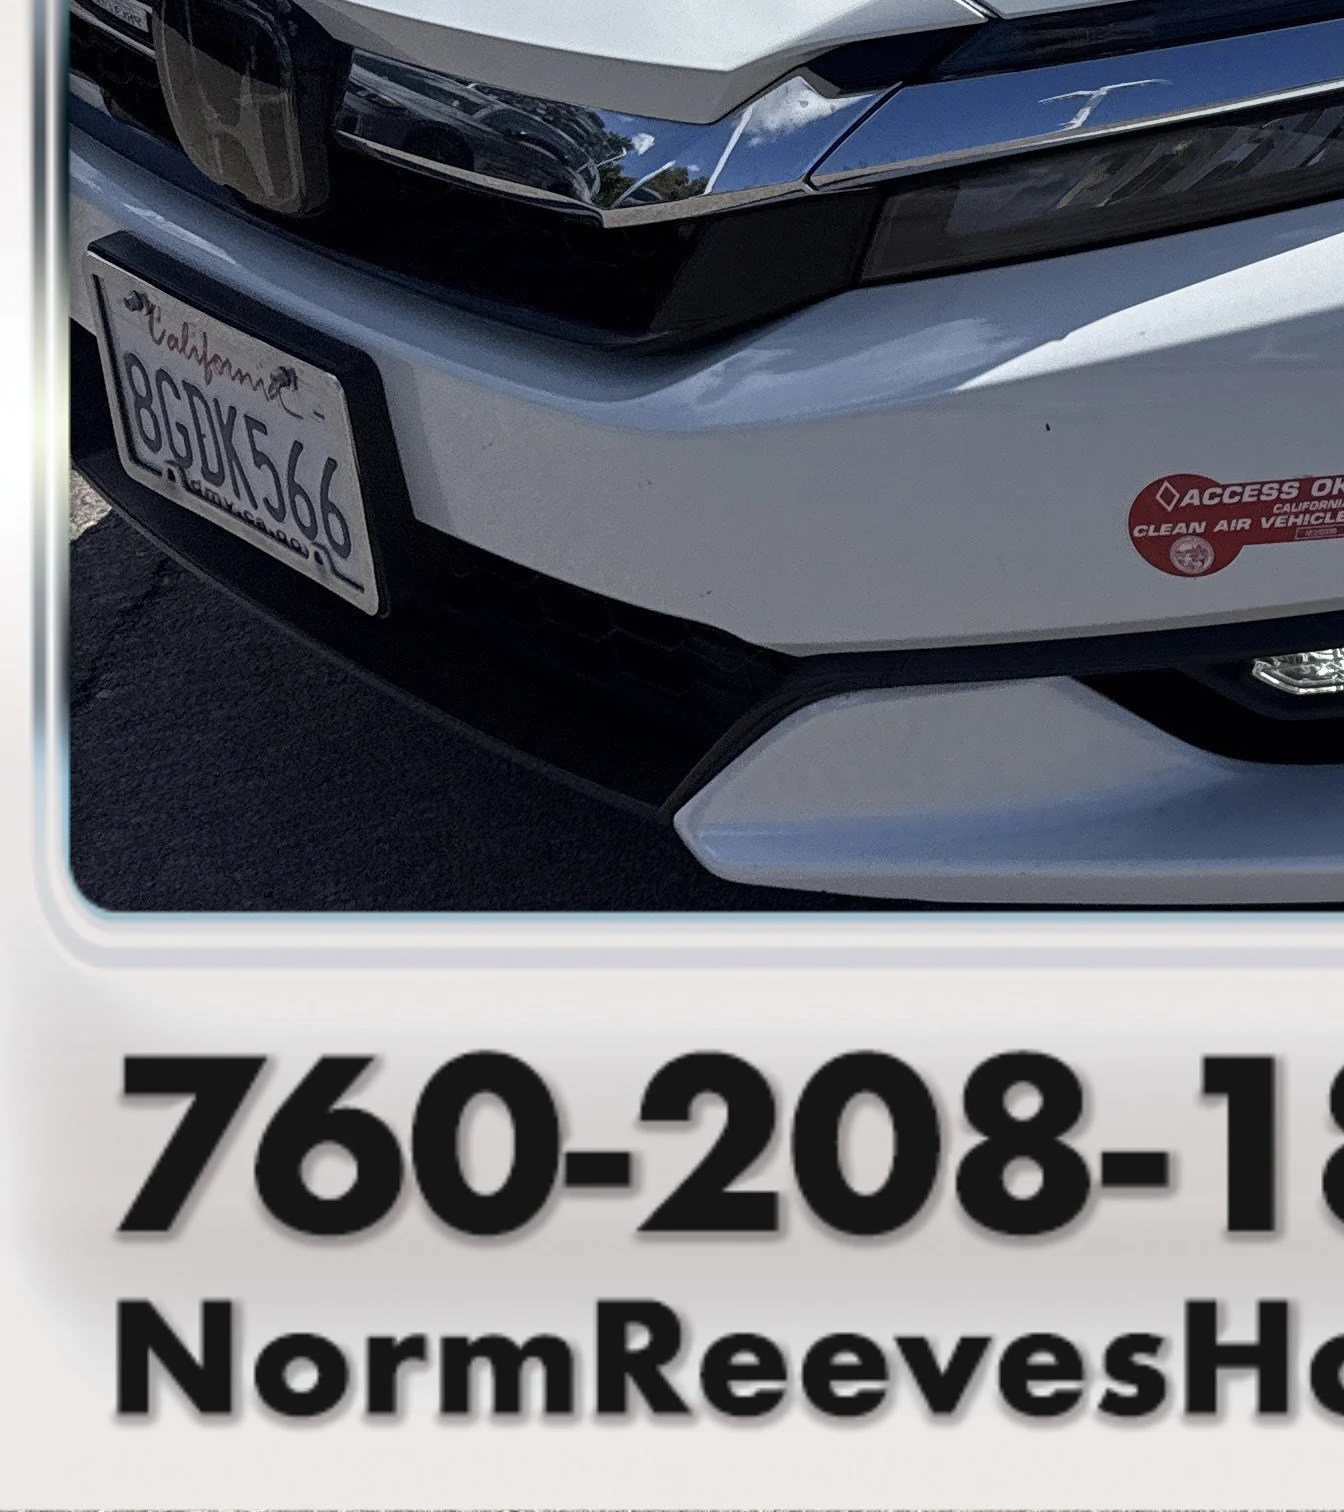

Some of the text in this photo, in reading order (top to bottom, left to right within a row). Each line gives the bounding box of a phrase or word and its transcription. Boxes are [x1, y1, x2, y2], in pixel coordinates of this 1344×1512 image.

[143, 300, 292, 404] California
[123, 352, 352, 560] 8GDK566
[1179, 481, 1301, 508] ACCESS
[1132, 520, 1206, 538] CLEAN
[1212, 517, 1252, 533] AIR
